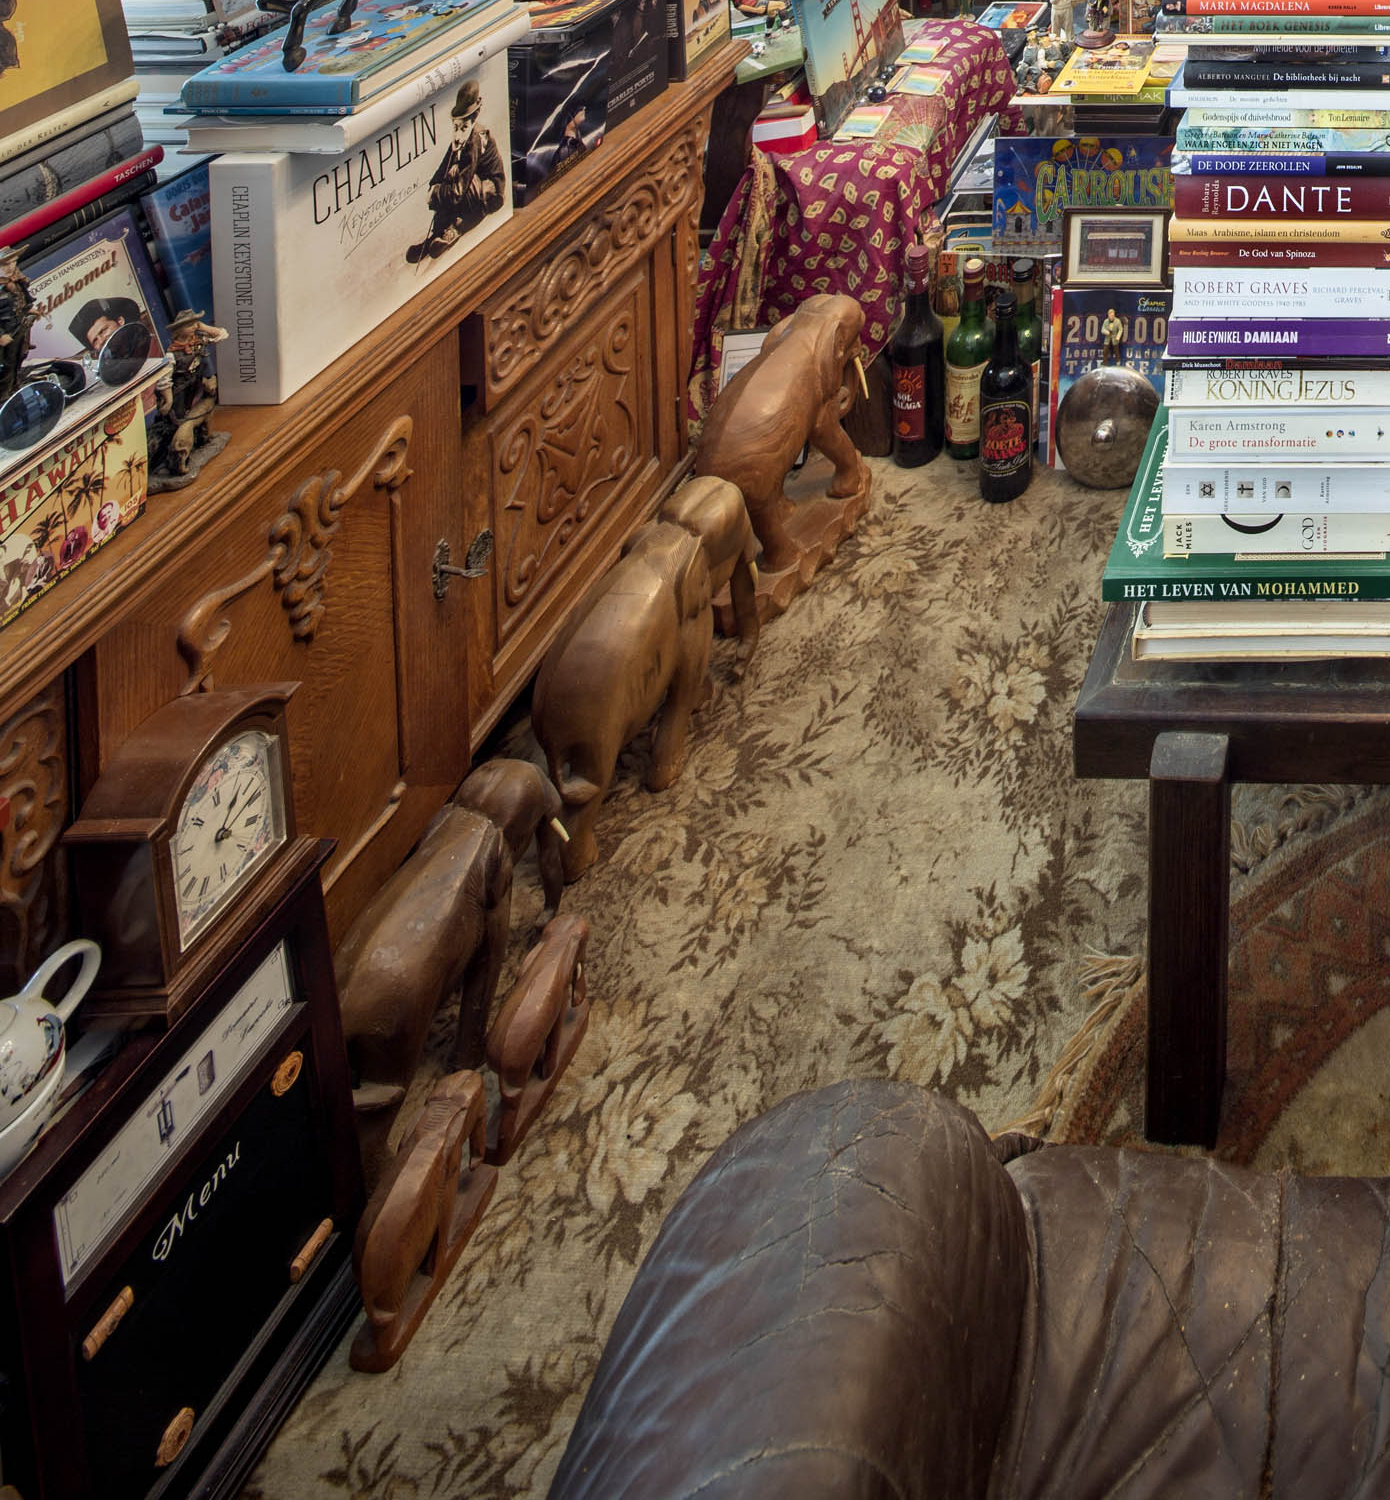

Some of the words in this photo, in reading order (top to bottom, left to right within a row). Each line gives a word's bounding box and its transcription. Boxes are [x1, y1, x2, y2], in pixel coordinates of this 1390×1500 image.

[1200, 1, 1237, 11] MARIA
[1240, 1, 1310, 11] MAGDALENA
[1273, 73, 1284, 81] De
[1286, 73, 1327, 82] bibliotheek
[1330, 73, 1338, 83] bij
[1340, 74, 1360, 82] nacht
[1202, 113, 1239, 123] Godenspijs
[1241, 113, 1247, 121] of
[17, 140, 32, 149] DER
[38, 123, 68, 140] KELTEN
[1211, 141, 1248, 149] ENGELEN
[1272, 141, 1291, 149] NIET
[114, 157, 154, 183] TASCHEN
[311, 103, 438, 226] CHAPLIN
[1198, 161, 1213, 170] DE
[1215, 161, 1246, 171] DODE
[1249, 161, 1310, 172] ZEEROLLEN
[1227, 185, 1352, 212] DANTE
[231, 185, 251, 239] CHAPLIN
[339, 188, 398, 245] KEYSTONE
[356, 178, 420, 241] COLLECTION
[1289, 228, 1340, 237] christendom
[1239, 249, 1249, 257] De
[1251, 249, 1268, 257] God
[1286, 249, 1315, 259] Spinoza
[233, 242, 254, 307] KEYSTONE
[1184, 282, 1244, 294] ROBERT
[1250, 282, 1308, 294] GRAVES
[238, 310, 257, 383] COLLECTION
[1183, 331, 1207, 343] HILDE
[1209, 331, 1241, 343] EYNIKEL
[1244, 331, 1298, 343] DAMIAAN
[1225, 359, 1283, 369] Damiaan
[1206, 381, 1293, 400] KONING
[1295, 381, 1355, 402] JEZUS
[1189, 420, 1222, 432] Karen
[1227, 420, 1286, 434] Armstrong
[1189, 437, 1206, 448] De
[1209, 438, 1238, 451] grote
[1242, 436, 1317, 448] transformatie
[0, 439, 96, 534] HAWAII
[1139, 506, 1157, 532] HET
[1302, 517, 1315, 550] GOD
[1124, 585, 1157, 598] HET
[1162, 584, 1215, 597] LEVEN
[1220, 583, 1252, 596] VAN
[1256, 582, 1360, 596] MOHAMMED
[152, 1140, 241, 1261] Menu
